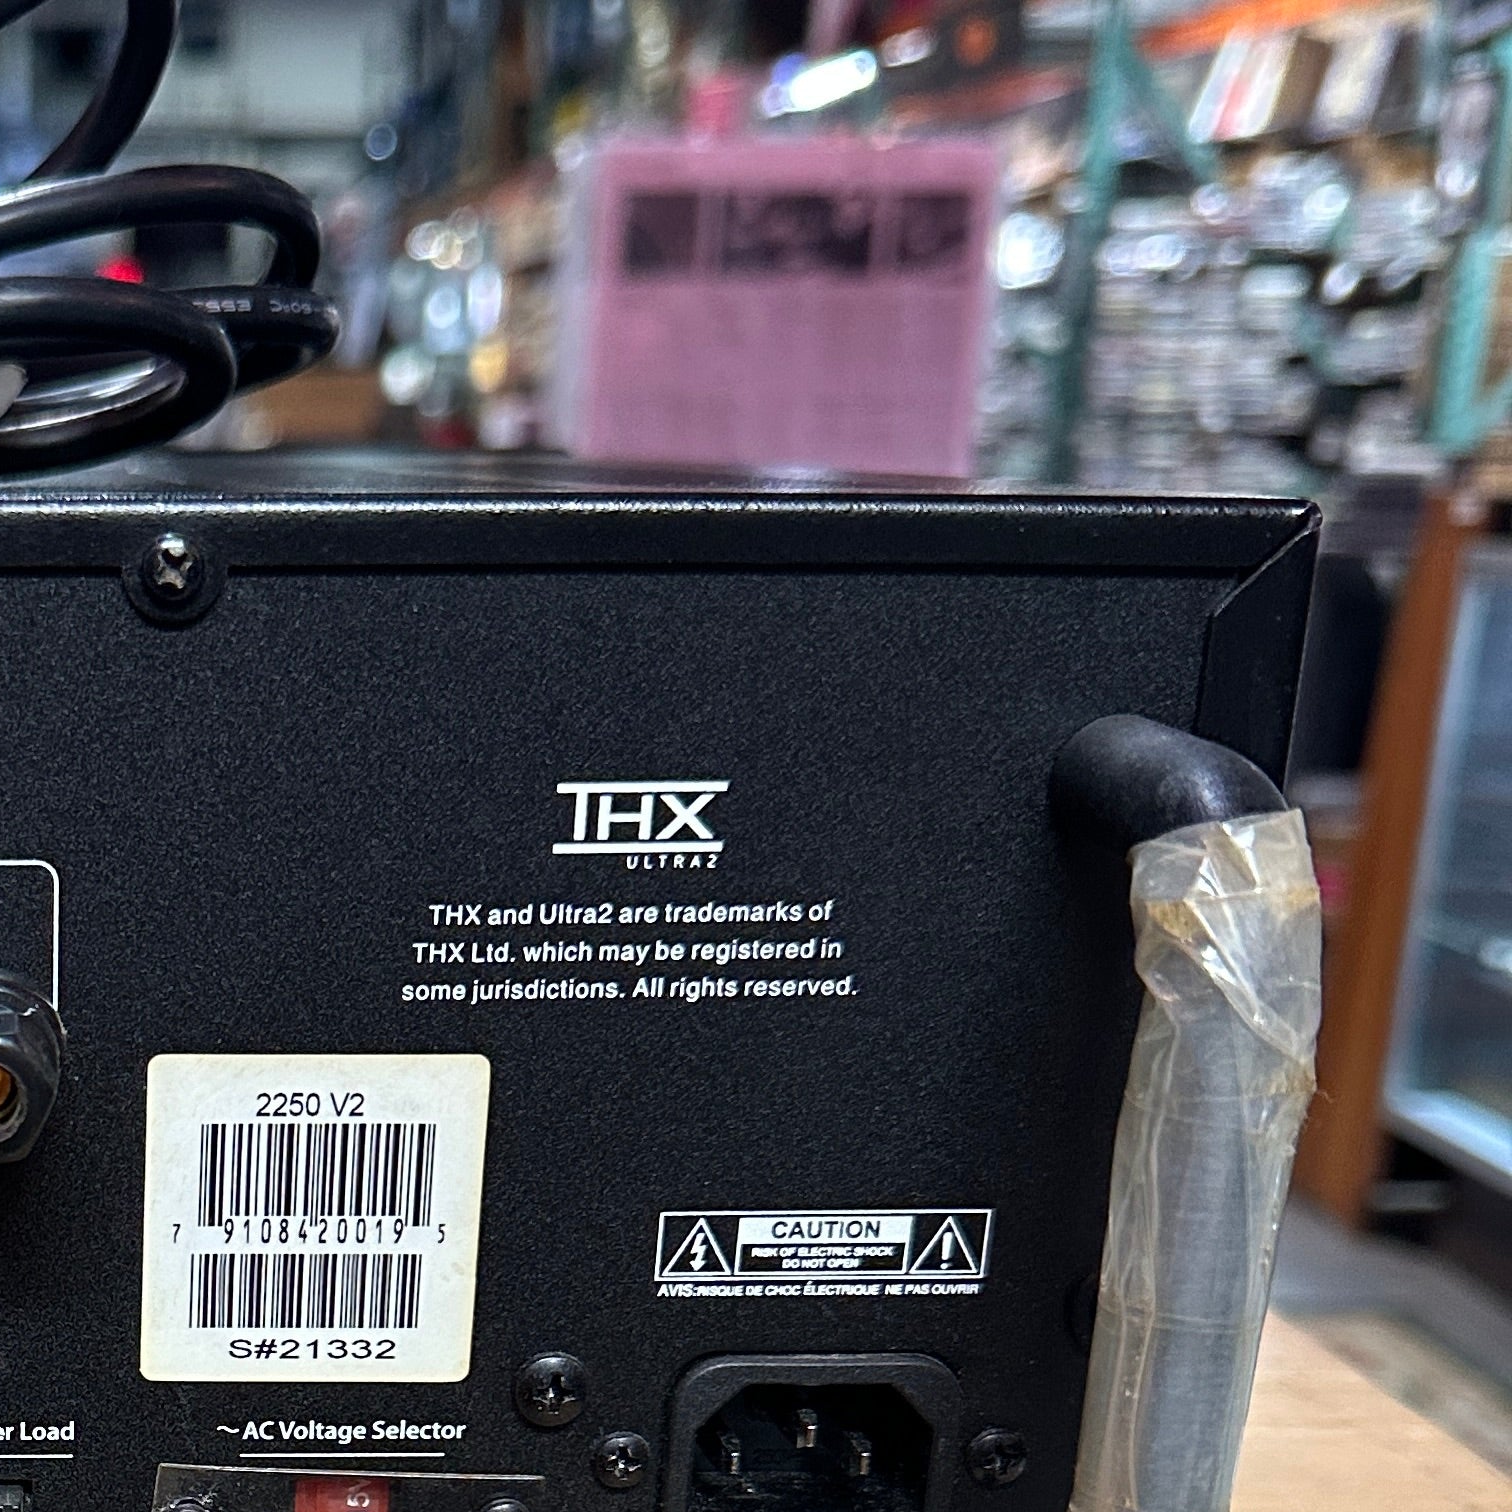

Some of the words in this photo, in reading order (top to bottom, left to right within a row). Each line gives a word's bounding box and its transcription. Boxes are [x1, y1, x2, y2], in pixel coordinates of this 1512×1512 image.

[551, 780, 730, 856] THX
[626, 853, 718, 870] ULTRA2
[428, 903, 483, 926] THX
[487, 903, 534, 926] and
[539, 902, 614, 925] Ultra2
[618, 905, 659, 924] are
[664, 900, 804, 924] trademarks
[808, 899, 834, 922] of
[412, 942, 465, 964] THX
[471, 941, 516, 964] Ltd.
[522, 940, 593, 962] which
[598, 944, 651, 966] may
[654, 939, 686, 961] be
[690, 938, 816, 965] registered
[820, 937, 842, 959] in
[401, 983, 467, 1002] some
[470, 978, 626, 1005] jurisdictions.
[631, 977, 665, 998] All
[669, 976, 738, 1003] rights
[743, 975, 858, 997] reserved.
[255, 1092, 321, 1117] 2250
[330, 1092, 365, 1117] V2
[771, 1220, 881, 1239] CAUTION
[797, 1246, 853, 1257] ELECTRIC
[853, 1245, 895, 1257] SHOCK
[781, 1258, 801, 1269] DO
[800, 1257, 827, 1269] NOT
[827, 1257, 861, 1269] OPEN
[744, 1284, 764, 1297] DE
[764, 1284, 803, 1297] CHOC
[884, 1283, 904, 1296] NE
[903, 1283, 931, 1295] PAS
[228, 1338, 396, 1360] S#21332
[19, 1420, 75, 1441] Load
[278, 1419, 367, 1445] Voltage
[371, 1419, 467, 1440] Selector
